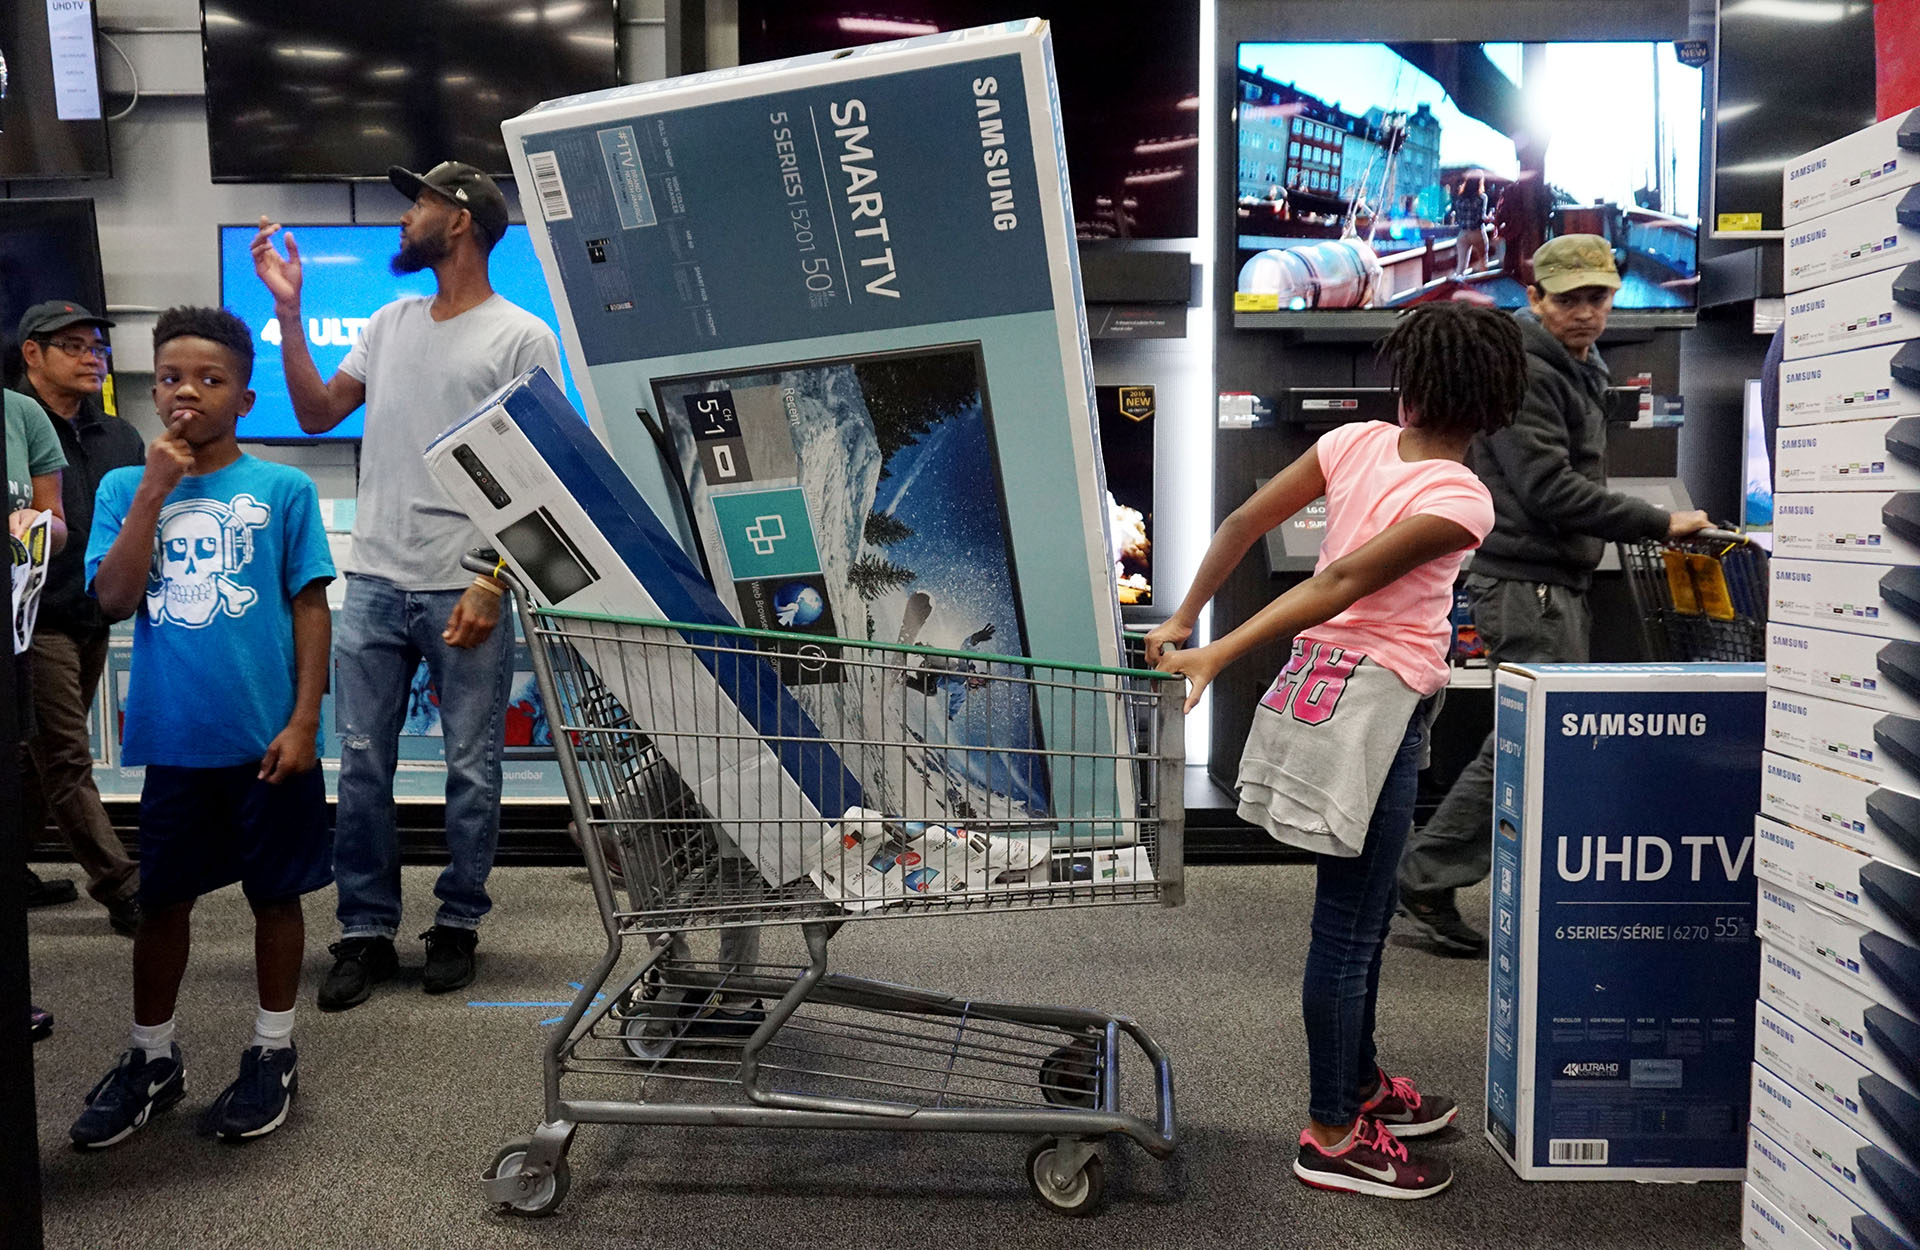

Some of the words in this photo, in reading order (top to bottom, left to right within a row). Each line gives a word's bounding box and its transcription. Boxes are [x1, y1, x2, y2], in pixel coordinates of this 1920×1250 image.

[53, 2, 71, 11] UHD
[73, 2, 84, 10] TV
[1681, 48, 1706, 57] NEW
[770, 112, 788, 125] 5
[773, 128, 804, 198] SERIES
[972, 76, 1017, 231] SAMSUNG
[1790, 159, 1827, 180] SAMSUNG
[630, 169, 641, 192] BRAND
[625, 170, 635, 194] NORTH
[631, 194, 642, 223] AMERICA
[830, 99, 890, 242] SMART
[860, 248, 900, 298] TV
[791, 208, 816, 252] 5201
[1790, 228, 1827, 248] SAMSUNG
[1790, 299, 1825, 315] SAMSUNG
[1786, 370, 1822, 383] SAMSUNG
[783, 386, 801, 426] Recent
[1126, 397, 1151, 406] NEW
[697, 399, 725, 435] 5-1
[722, 407, 733, 422] CH
[1781, 438, 1817, 449] SAMSUNG
[1779, 505, 1814, 515] SAMSUNG
[1775, 571, 1812, 583] SAMSUNG
[752, 581, 761, 599] Web
[1772, 635, 1809, 650] SAMSUNG
[1500, 695, 1524, 713] SAMSUNG
[1772, 700, 1807, 716] SAMSUNG
[1562, 713, 1706, 736] SAMSUNG
[1499, 737, 1512, 754] UHD
[1513, 742, 1522, 758] TV
[502, 770, 544, 780] oundbar
[1767, 765, 1801, 783] SAMSUNG
[1760, 829, 1795, 850] SAMSUNG
[1556, 835, 1672, 882] UHD
[1681, 836, 1753, 882] TV
[1763, 890, 1796, 913] SAMSUNG
[1555, 927, 1565, 939] 6
[1674, 926, 1709, 940] 6270
[1767, 954, 1801, 980] SAMSUNG
[1761, 1016, 1795, 1044] SAMSUNG
[1578, 1063, 1606, 1071] ULTRA
[1606, 1063, 1618, 1071] HD
[1758, 1078, 1792, 1109] SAMSUNG
[1754, 1139, 1787, 1172] SAMSUNG
[1751, 1199, 1786, 1235] SAMSUNG
